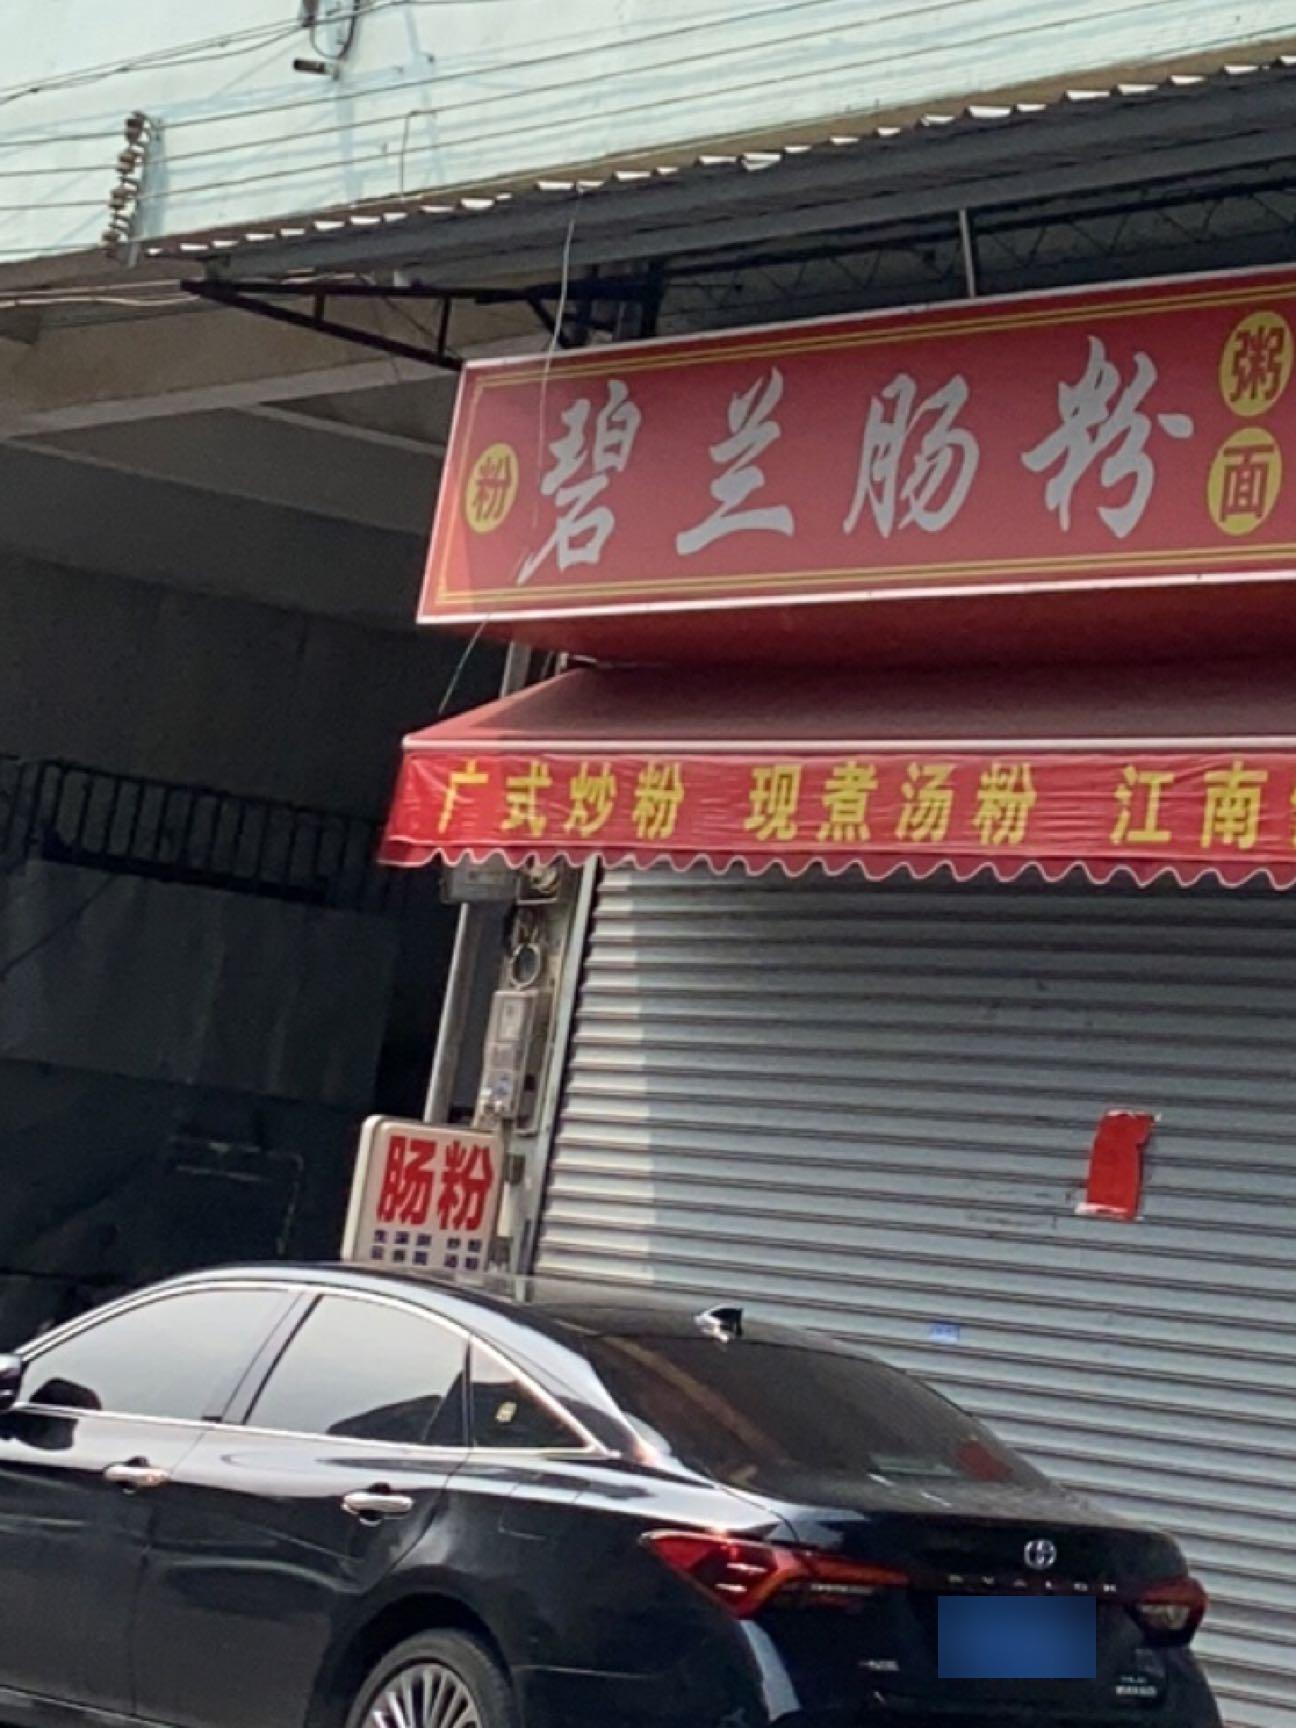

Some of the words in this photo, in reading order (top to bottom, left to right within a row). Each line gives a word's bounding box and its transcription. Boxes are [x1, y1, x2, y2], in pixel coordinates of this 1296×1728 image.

[470, 457, 516, 524] 粉
[517, 335, 1195, 585] 碧兰肠粉
[437, 760, 684, 840] 广式炒粉
[744, 760, 1037, 845] 现煮汤粉
[377, 1136, 492, 1230] 肠粉
